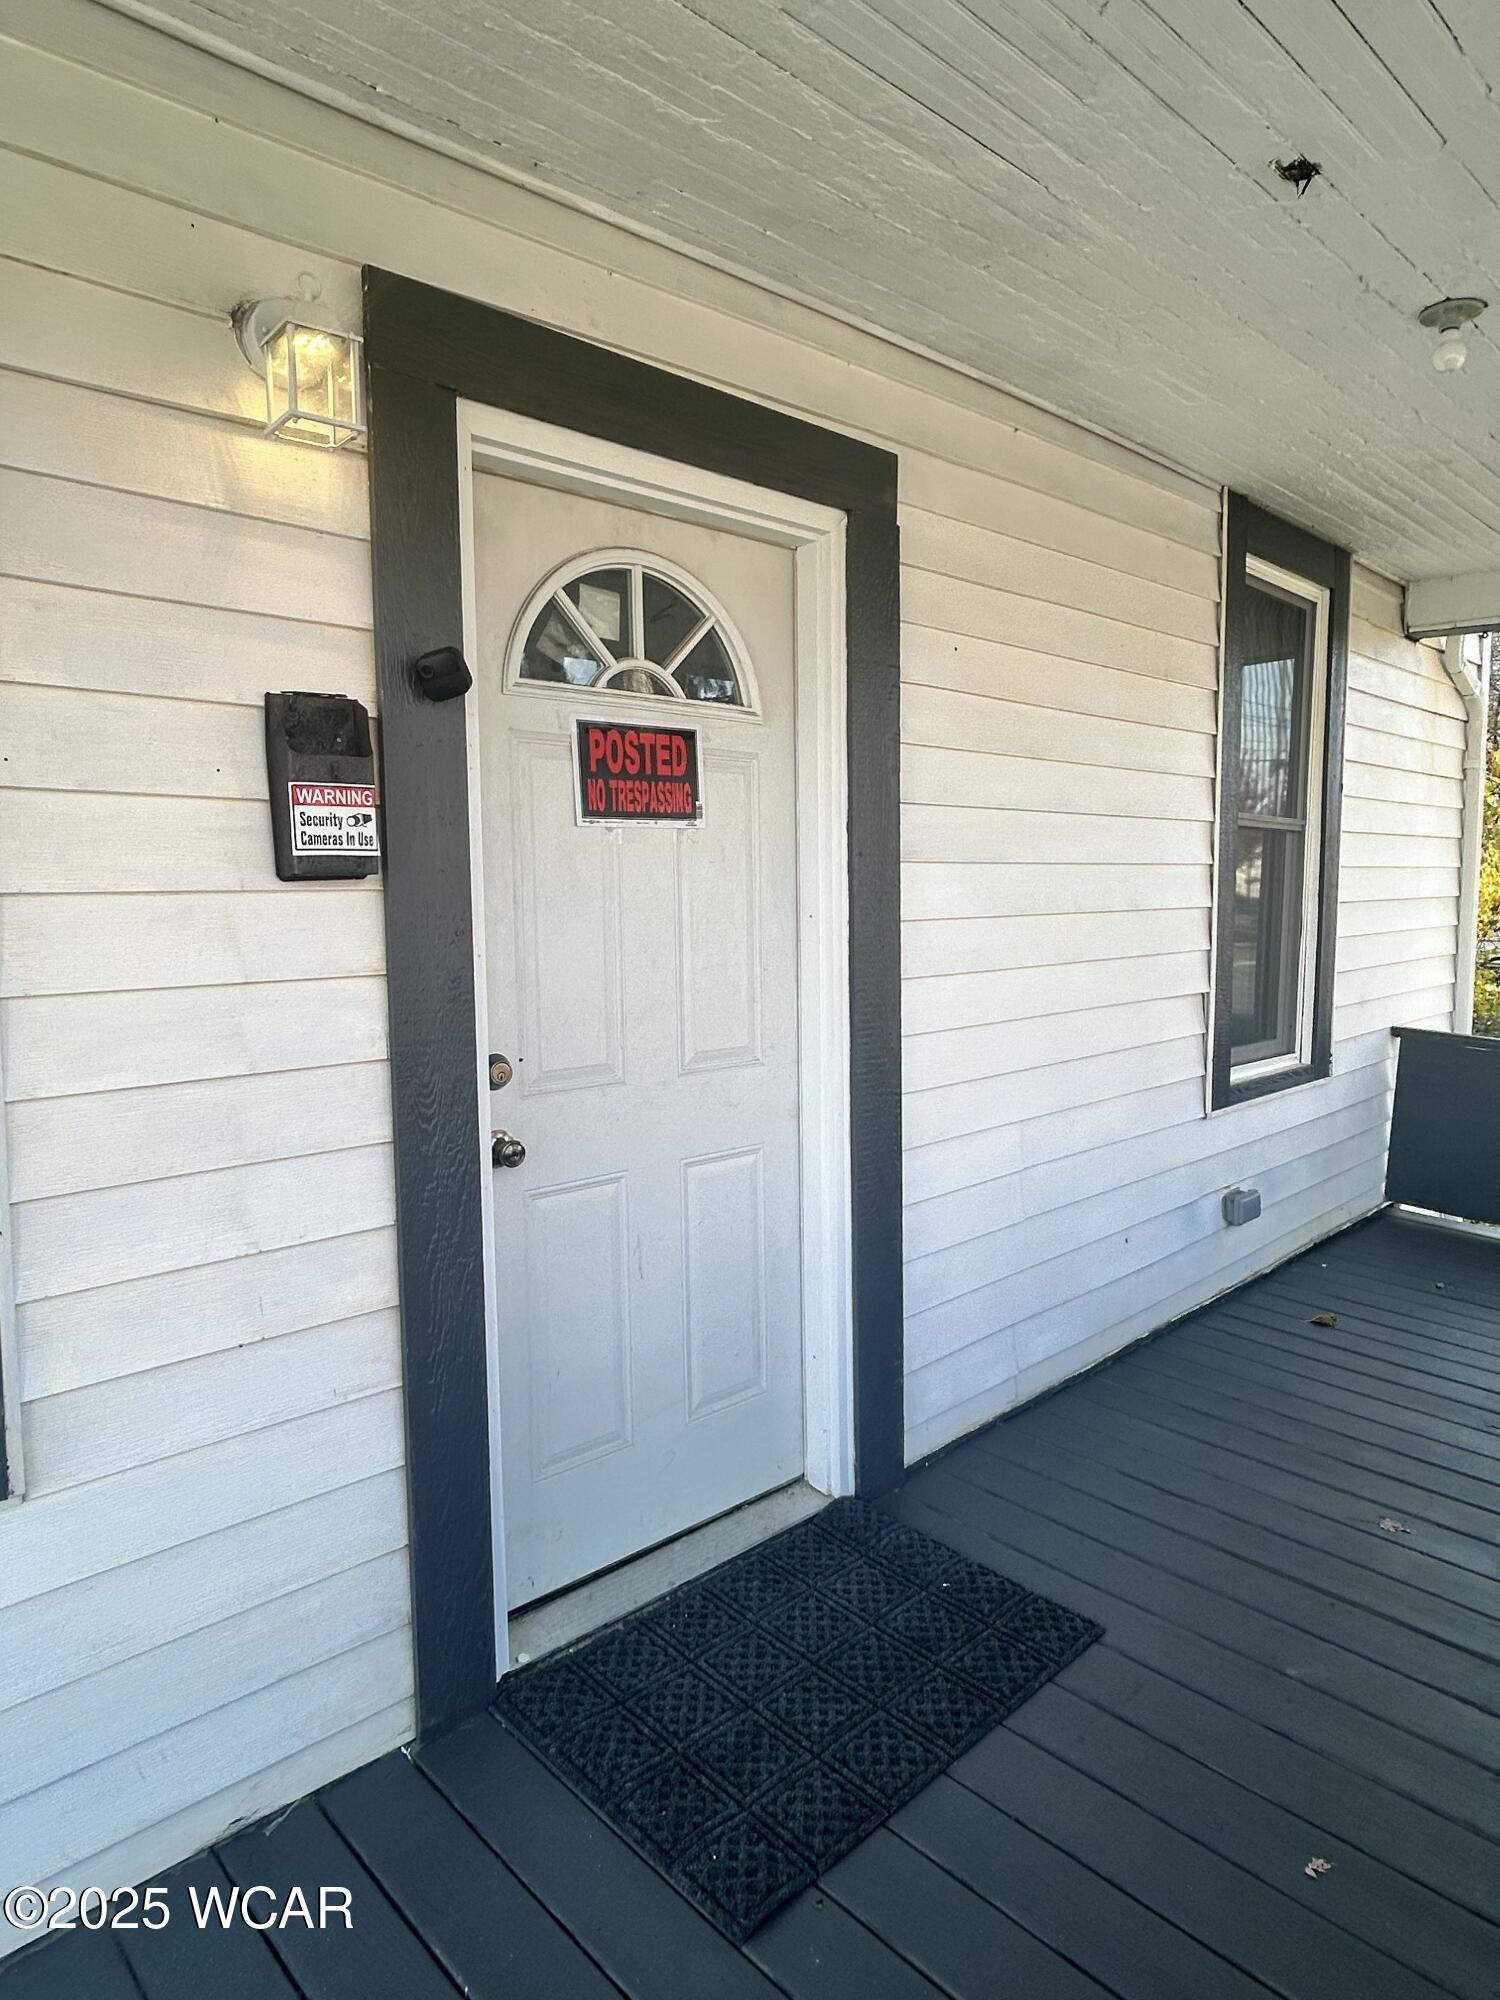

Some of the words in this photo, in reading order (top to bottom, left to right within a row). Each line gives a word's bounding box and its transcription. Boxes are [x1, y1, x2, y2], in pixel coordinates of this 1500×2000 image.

[588, 728, 687, 776] POSTED
[296, 788, 373, 805] WARNING
[587, 778, 606, 812] NO
[608, 779, 693, 814] TRESPASSING
[299, 812, 343, 830] Security
[300, 831, 344, 846] Cameras
[346, 832, 356, 846] In
[358, 831, 374, 847] Use
